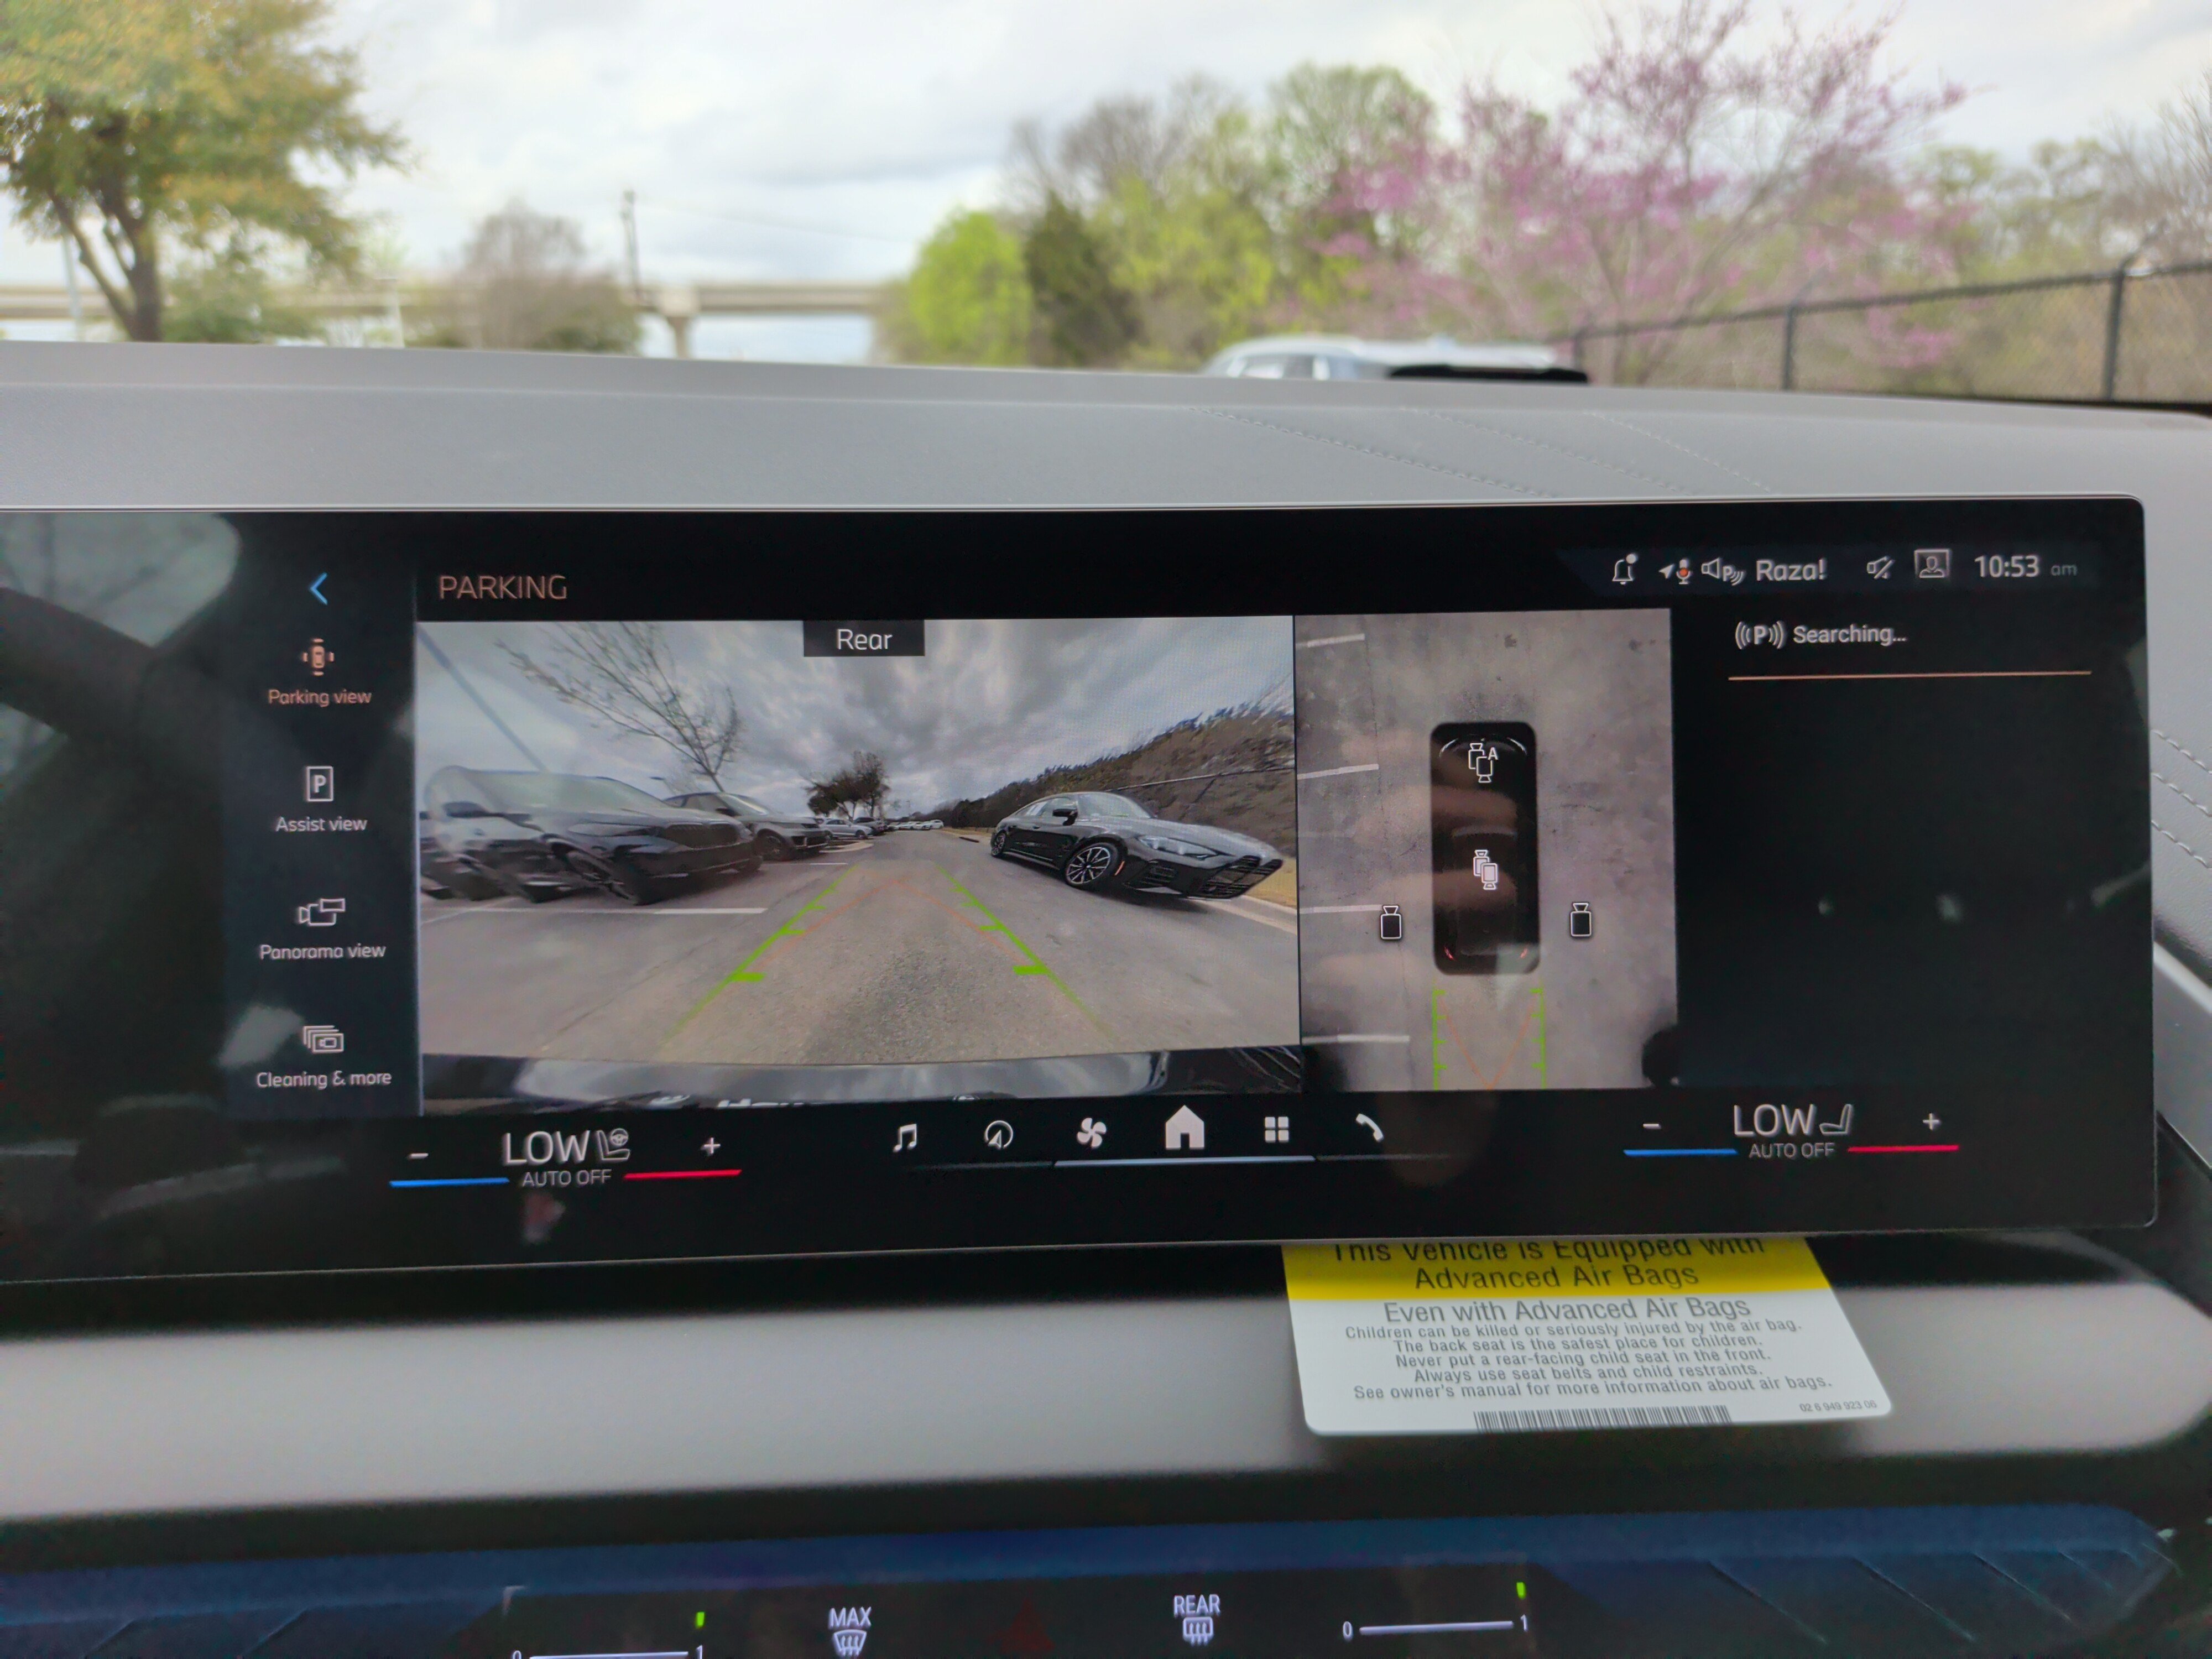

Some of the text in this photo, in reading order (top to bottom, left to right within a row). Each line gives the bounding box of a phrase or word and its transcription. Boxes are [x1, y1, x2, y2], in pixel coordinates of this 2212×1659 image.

[1756, 559, 1826, 581] Raza!
[1974, 555, 2078, 577] 10:53 am
[439, 576, 567, 599] PARKING
[837, 629, 893, 650] Rear
[1793, 624, 1907, 646] Searching...
[268, 689, 372, 707] Parking view
[276, 817, 368, 831] Assist view
[260, 943, 387, 960] Panorama view
[257, 1071, 392, 1089] Cleaning & more
[1734, 1104, 1815, 1136] LOW
[503, 1130, 591, 1164] LOW
[1749, 1142, 1835, 1159] AUTO OFF
[521, 1169, 612, 1187] AUTO OFF
[1415, 1264, 1699, 1289] Advanced Air Bags
[1384, 1296, 1751, 1323] Even with Advanced Air Bags
[1345, 1318, 1802, 1339] Children can be killed or seriously injured by the air bag.
[1394, 1334, 1762, 1352] The back seat is the safest place for children.
[1396, 1348, 1771, 1368] Never put a rear-facing child seat in the front.
[1415, 1363, 1763, 1383] Always use seat belts and child restraints.
[1354, 1376, 1832, 1399] See owner's manual for more information about air bags.
[1799, 1404, 1813, 1412] 02
[1823, 1402, 1842, 1410] 949
[1844, 1401, 1862, 1409] 923
[1864, 1400, 1877, 1408] 06
[1173, 1594, 1220, 1616] REAR
[828, 1607, 871, 1629] MAX
